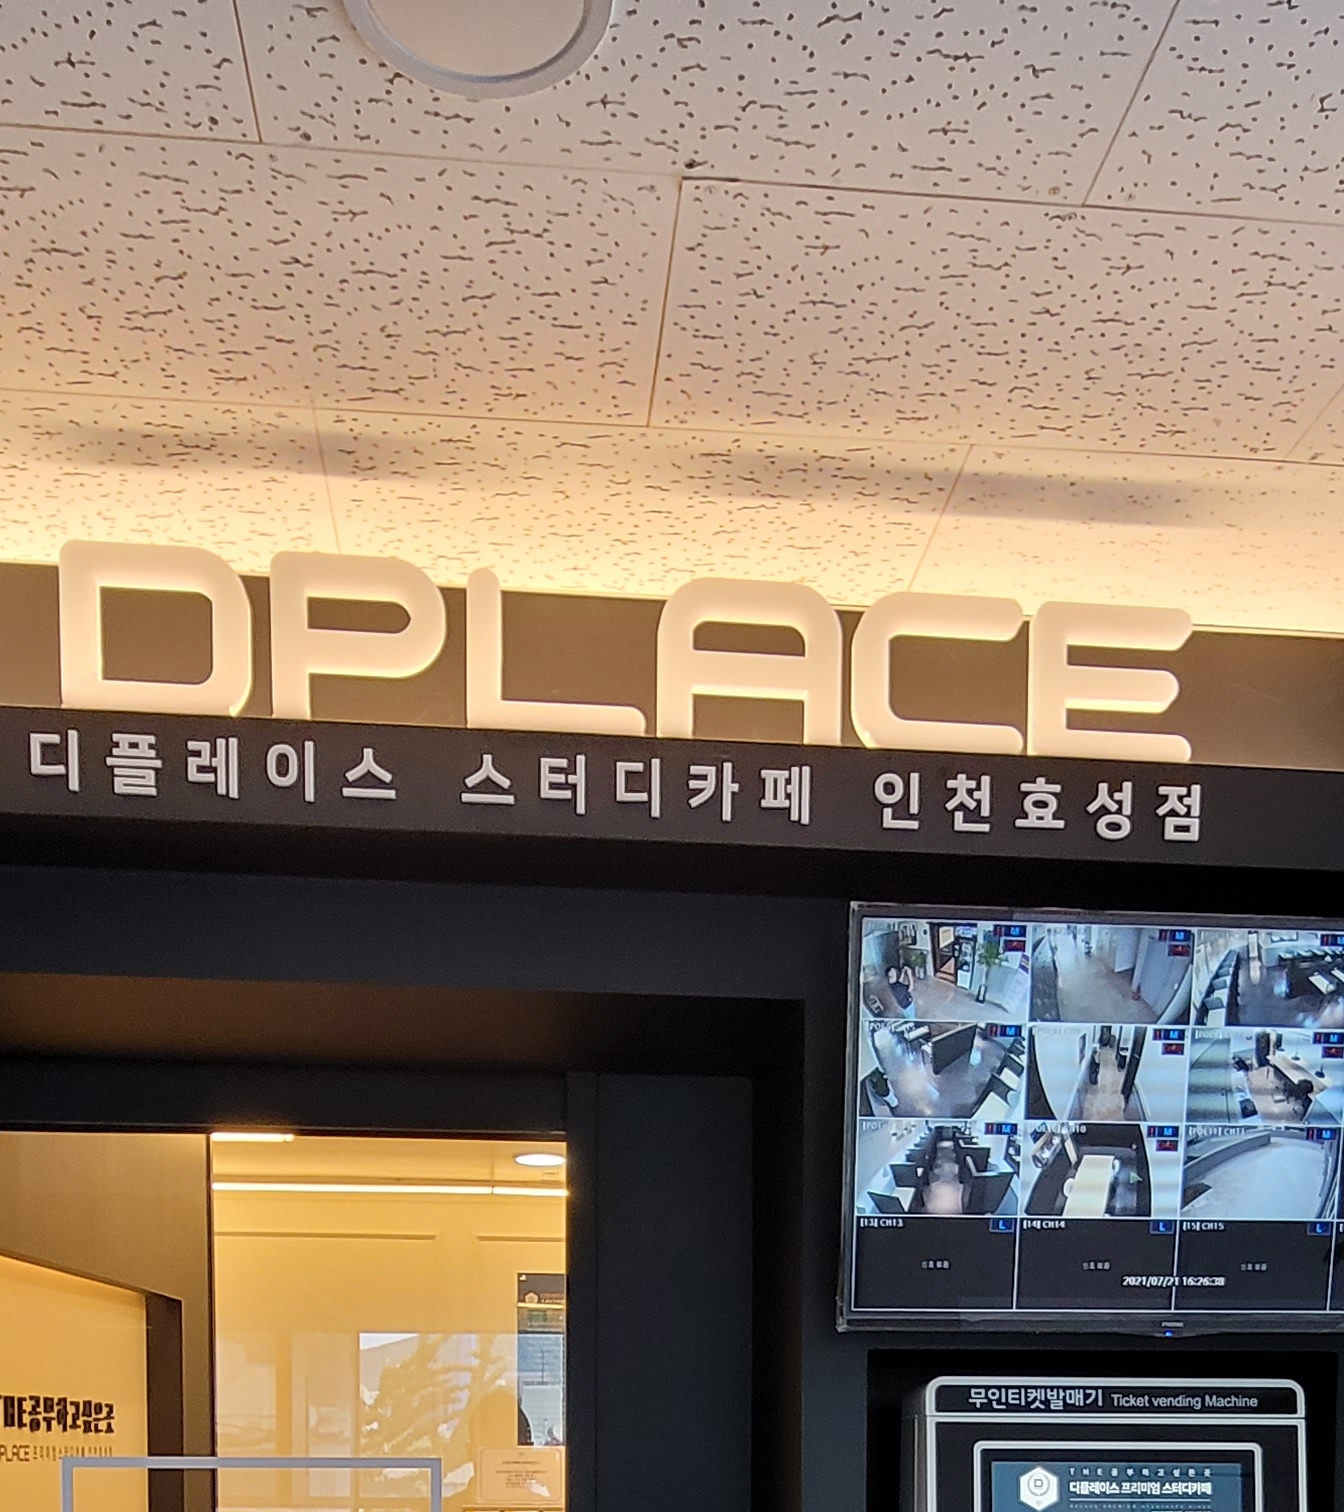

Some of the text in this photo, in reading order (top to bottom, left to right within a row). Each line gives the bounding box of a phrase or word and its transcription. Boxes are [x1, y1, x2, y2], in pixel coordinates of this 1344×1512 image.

[59, 539, 1194, 763] DPLACE
[27, 731, 1205, 843] 디플레이스 스터디카페 인천효성점
[968, 1387, 1259, 1411] 무인티켓발매기 Ticket vending Machine
[1069, 1481, 1212, 1496] 디플레이스 프리미엄 스터디카페
